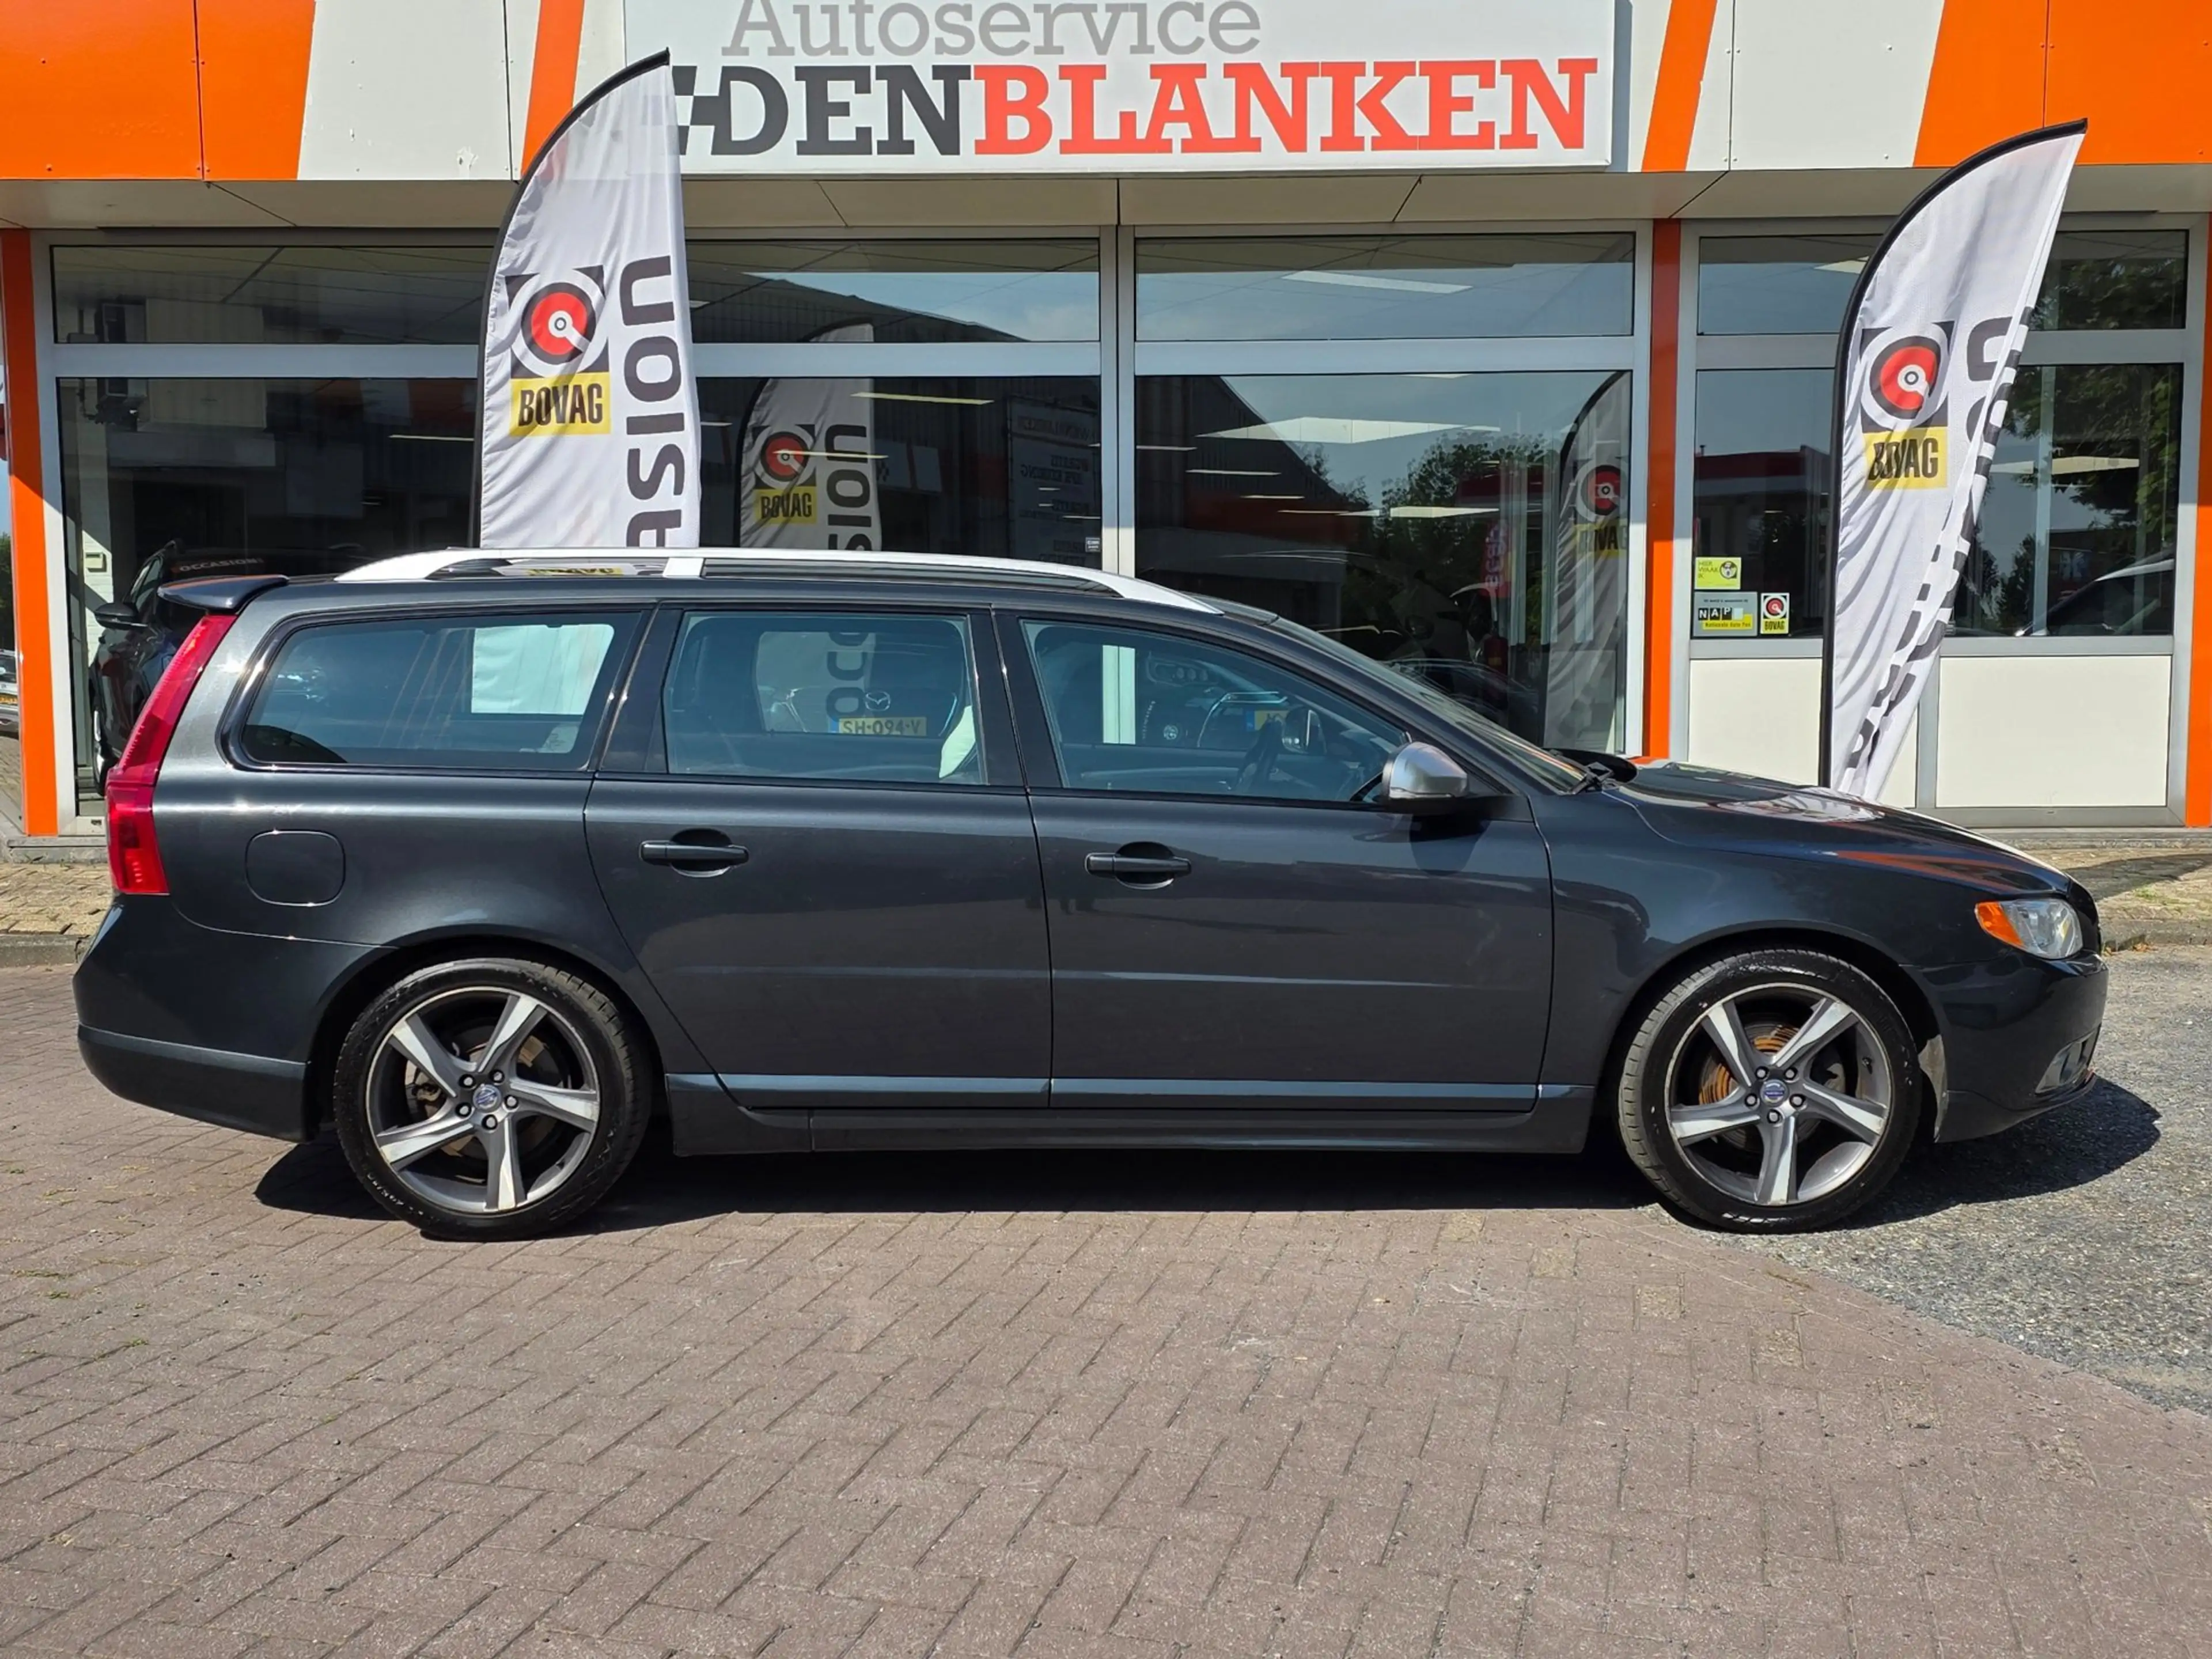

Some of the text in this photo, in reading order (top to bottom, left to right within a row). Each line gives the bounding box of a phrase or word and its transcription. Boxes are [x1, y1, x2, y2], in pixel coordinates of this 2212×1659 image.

[721, 0, 1261, 56] Autoservice
[518, 383, 603, 426] BOVAG
[760, 493, 812, 519] BOVAG
[1699, 607, 1731, 619] NAP
